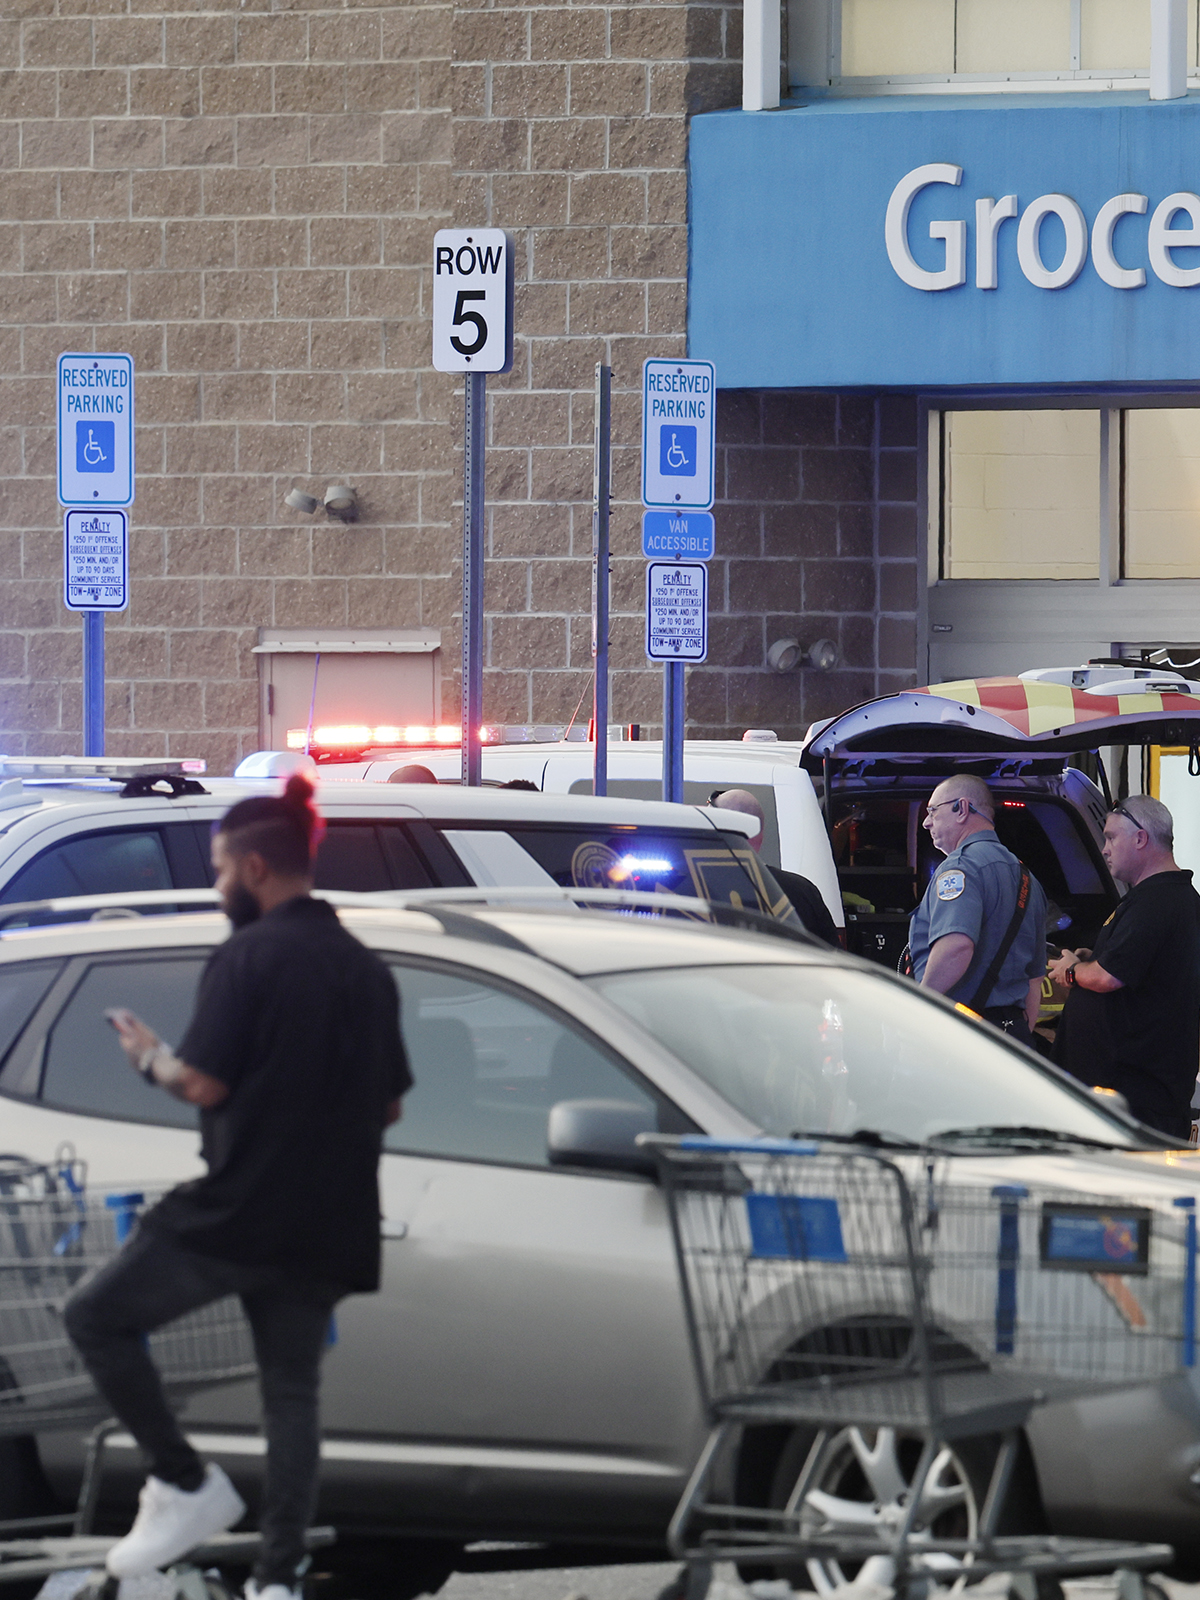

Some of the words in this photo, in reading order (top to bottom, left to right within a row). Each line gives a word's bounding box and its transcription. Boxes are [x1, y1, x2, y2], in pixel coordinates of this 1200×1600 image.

[436, 245, 503, 276] ROW
[450, 290, 488, 355] 5
[63, 368, 128, 388] RESERVED
[648, 373, 711, 394] RESERVED
[67, 394, 124, 414] PARKING
[652, 399, 706, 419] PARKING
[81, 522, 110, 532] PENALTY
[668, 519, 688, 534] VAN
[95, 536, 118, 544] OFFENSE
[647, 536, 710, 551] ACCESSIBLE
[93, 566, 100, 574] 90
[100, 576, 121, 584] SERVICE
[663, 574, 692, 585] PENALTY
[70, 586, 102, 596] TOW-AWAY
[104, 587, 122, 596] ZONE
[676, 588, 698, 596] OFFENSE
[683, 618, 695, 626] DAYS
[652, 627, 680, 635] COMMUNITY
[681, 628, 701, 636] SERVICE
[652, 637, 682, 647] TOW-AWAY
[685, 638, 702, 648] ZONE
